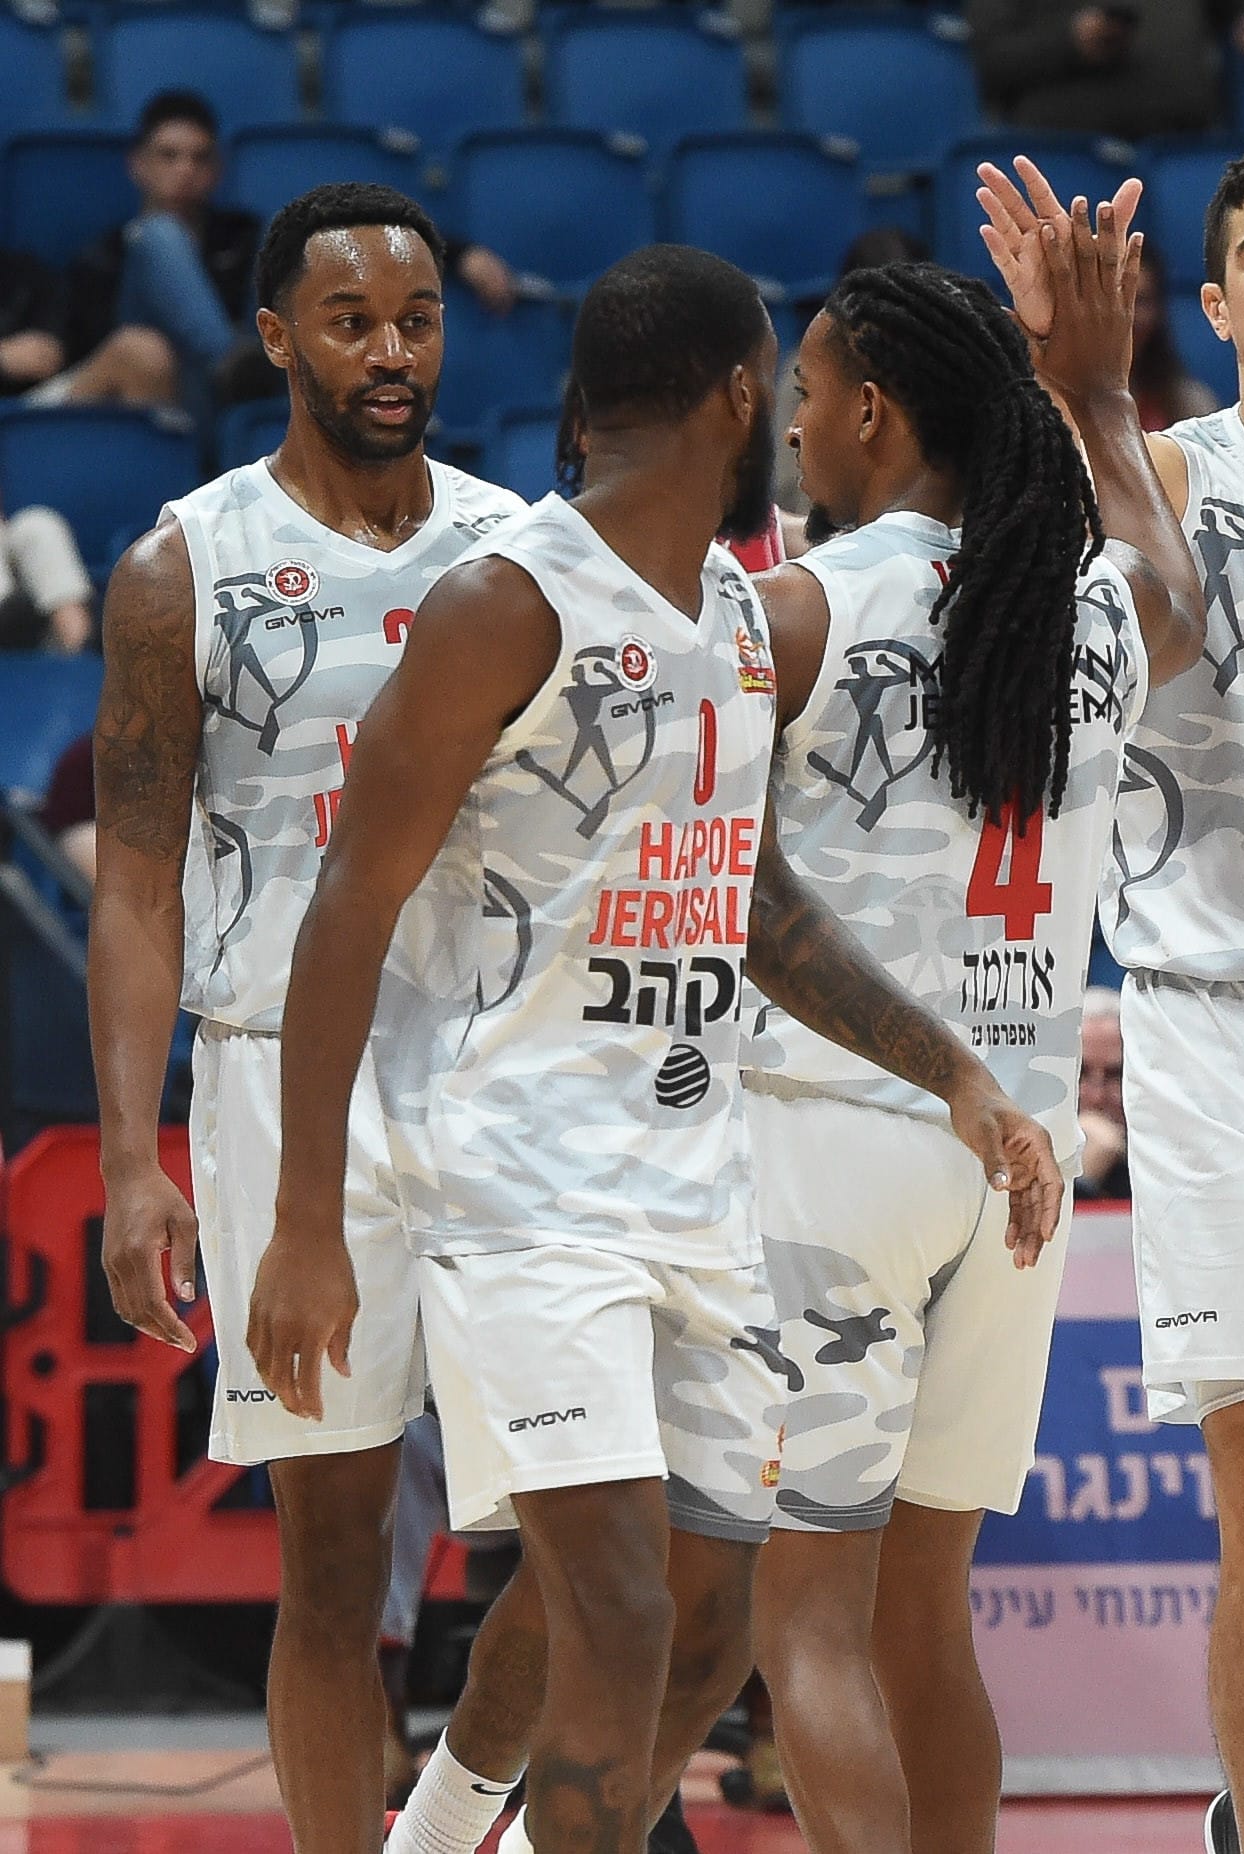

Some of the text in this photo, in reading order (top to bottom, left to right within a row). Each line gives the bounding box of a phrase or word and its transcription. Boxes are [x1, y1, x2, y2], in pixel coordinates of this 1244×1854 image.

[265, 606, 344, 630] GIVOVA
[639, 816, 754, 880] HAPOE
[966, 797, 1053, 941] 4
[589, 886, 752, 949] JERUSAL
[582, 956, 682, 1027] הב
[961, 947, 1055, 1012] ארומה
[1156, 1311, 1217, 1328] GIVOVA
[226, 1390, 277, 1402] IVOV
[509, 1407, 586, 1432] GIVOVA
